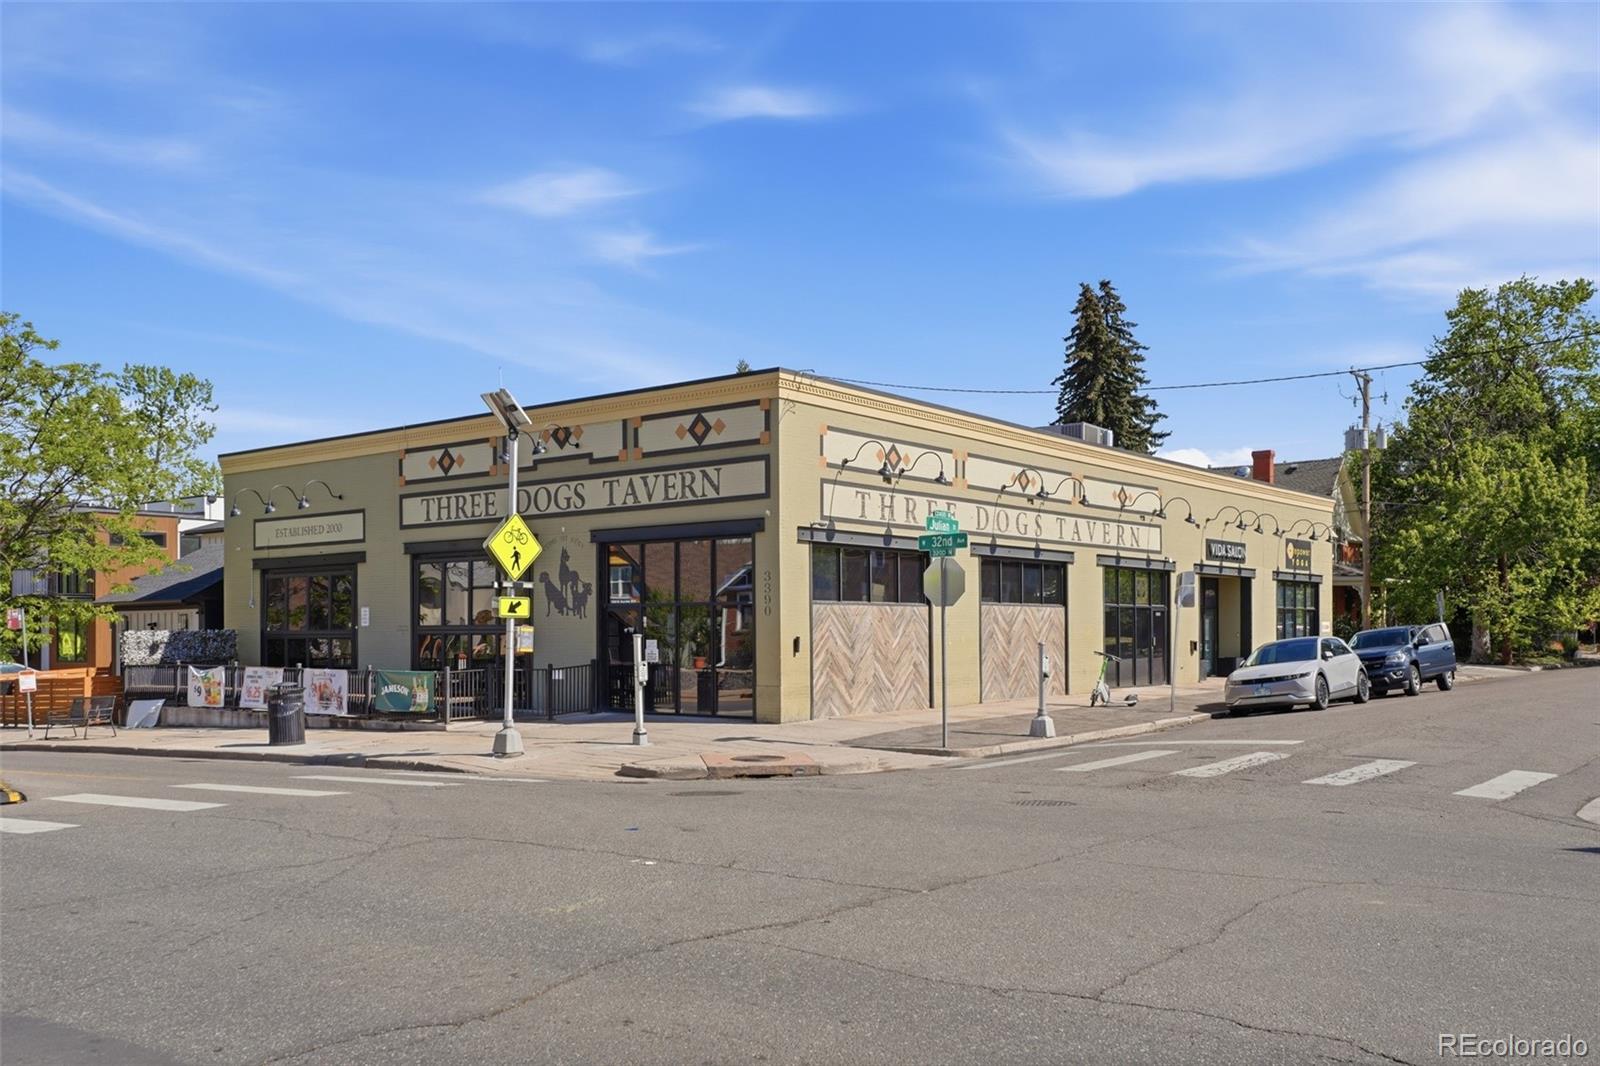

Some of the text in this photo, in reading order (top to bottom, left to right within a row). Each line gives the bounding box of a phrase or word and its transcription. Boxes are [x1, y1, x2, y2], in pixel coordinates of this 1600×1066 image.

[421, 467, 722, 522] THREE DOGS TAVERN
[275, 523, 343, 538] ESTABLISHED 2000
[929, 520, 950, 531] Julian
[976, 506, 1043, 537] DOGS
[1056, 517, 1140, 547] TAVERN
[931, 536, 953, 548] 32nd
[1210, 543, 1246, 559] VIDA SALON
[381, 684, 410, 696] JAMESON
